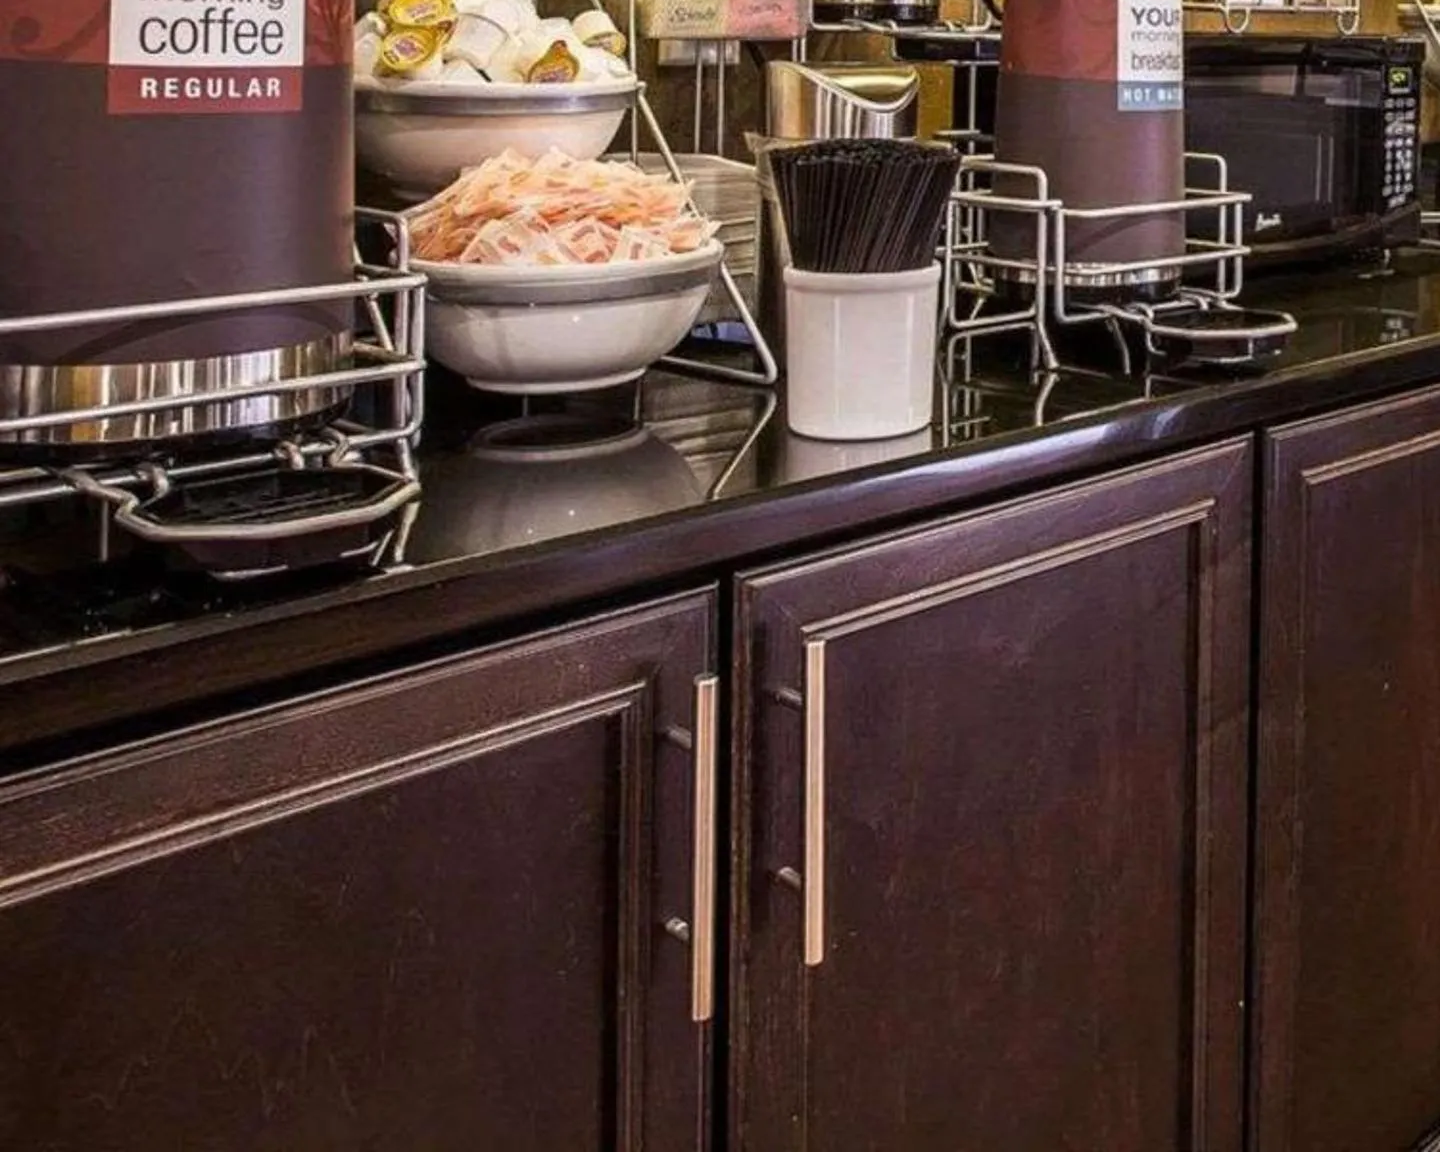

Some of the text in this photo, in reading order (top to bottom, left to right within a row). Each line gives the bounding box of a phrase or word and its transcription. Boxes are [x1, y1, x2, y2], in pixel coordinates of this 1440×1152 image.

[139, 7, 284, 55] coffee
[140, 76, 282, 99] REGULAR
[1123, 87, 1150, 103] HOT
